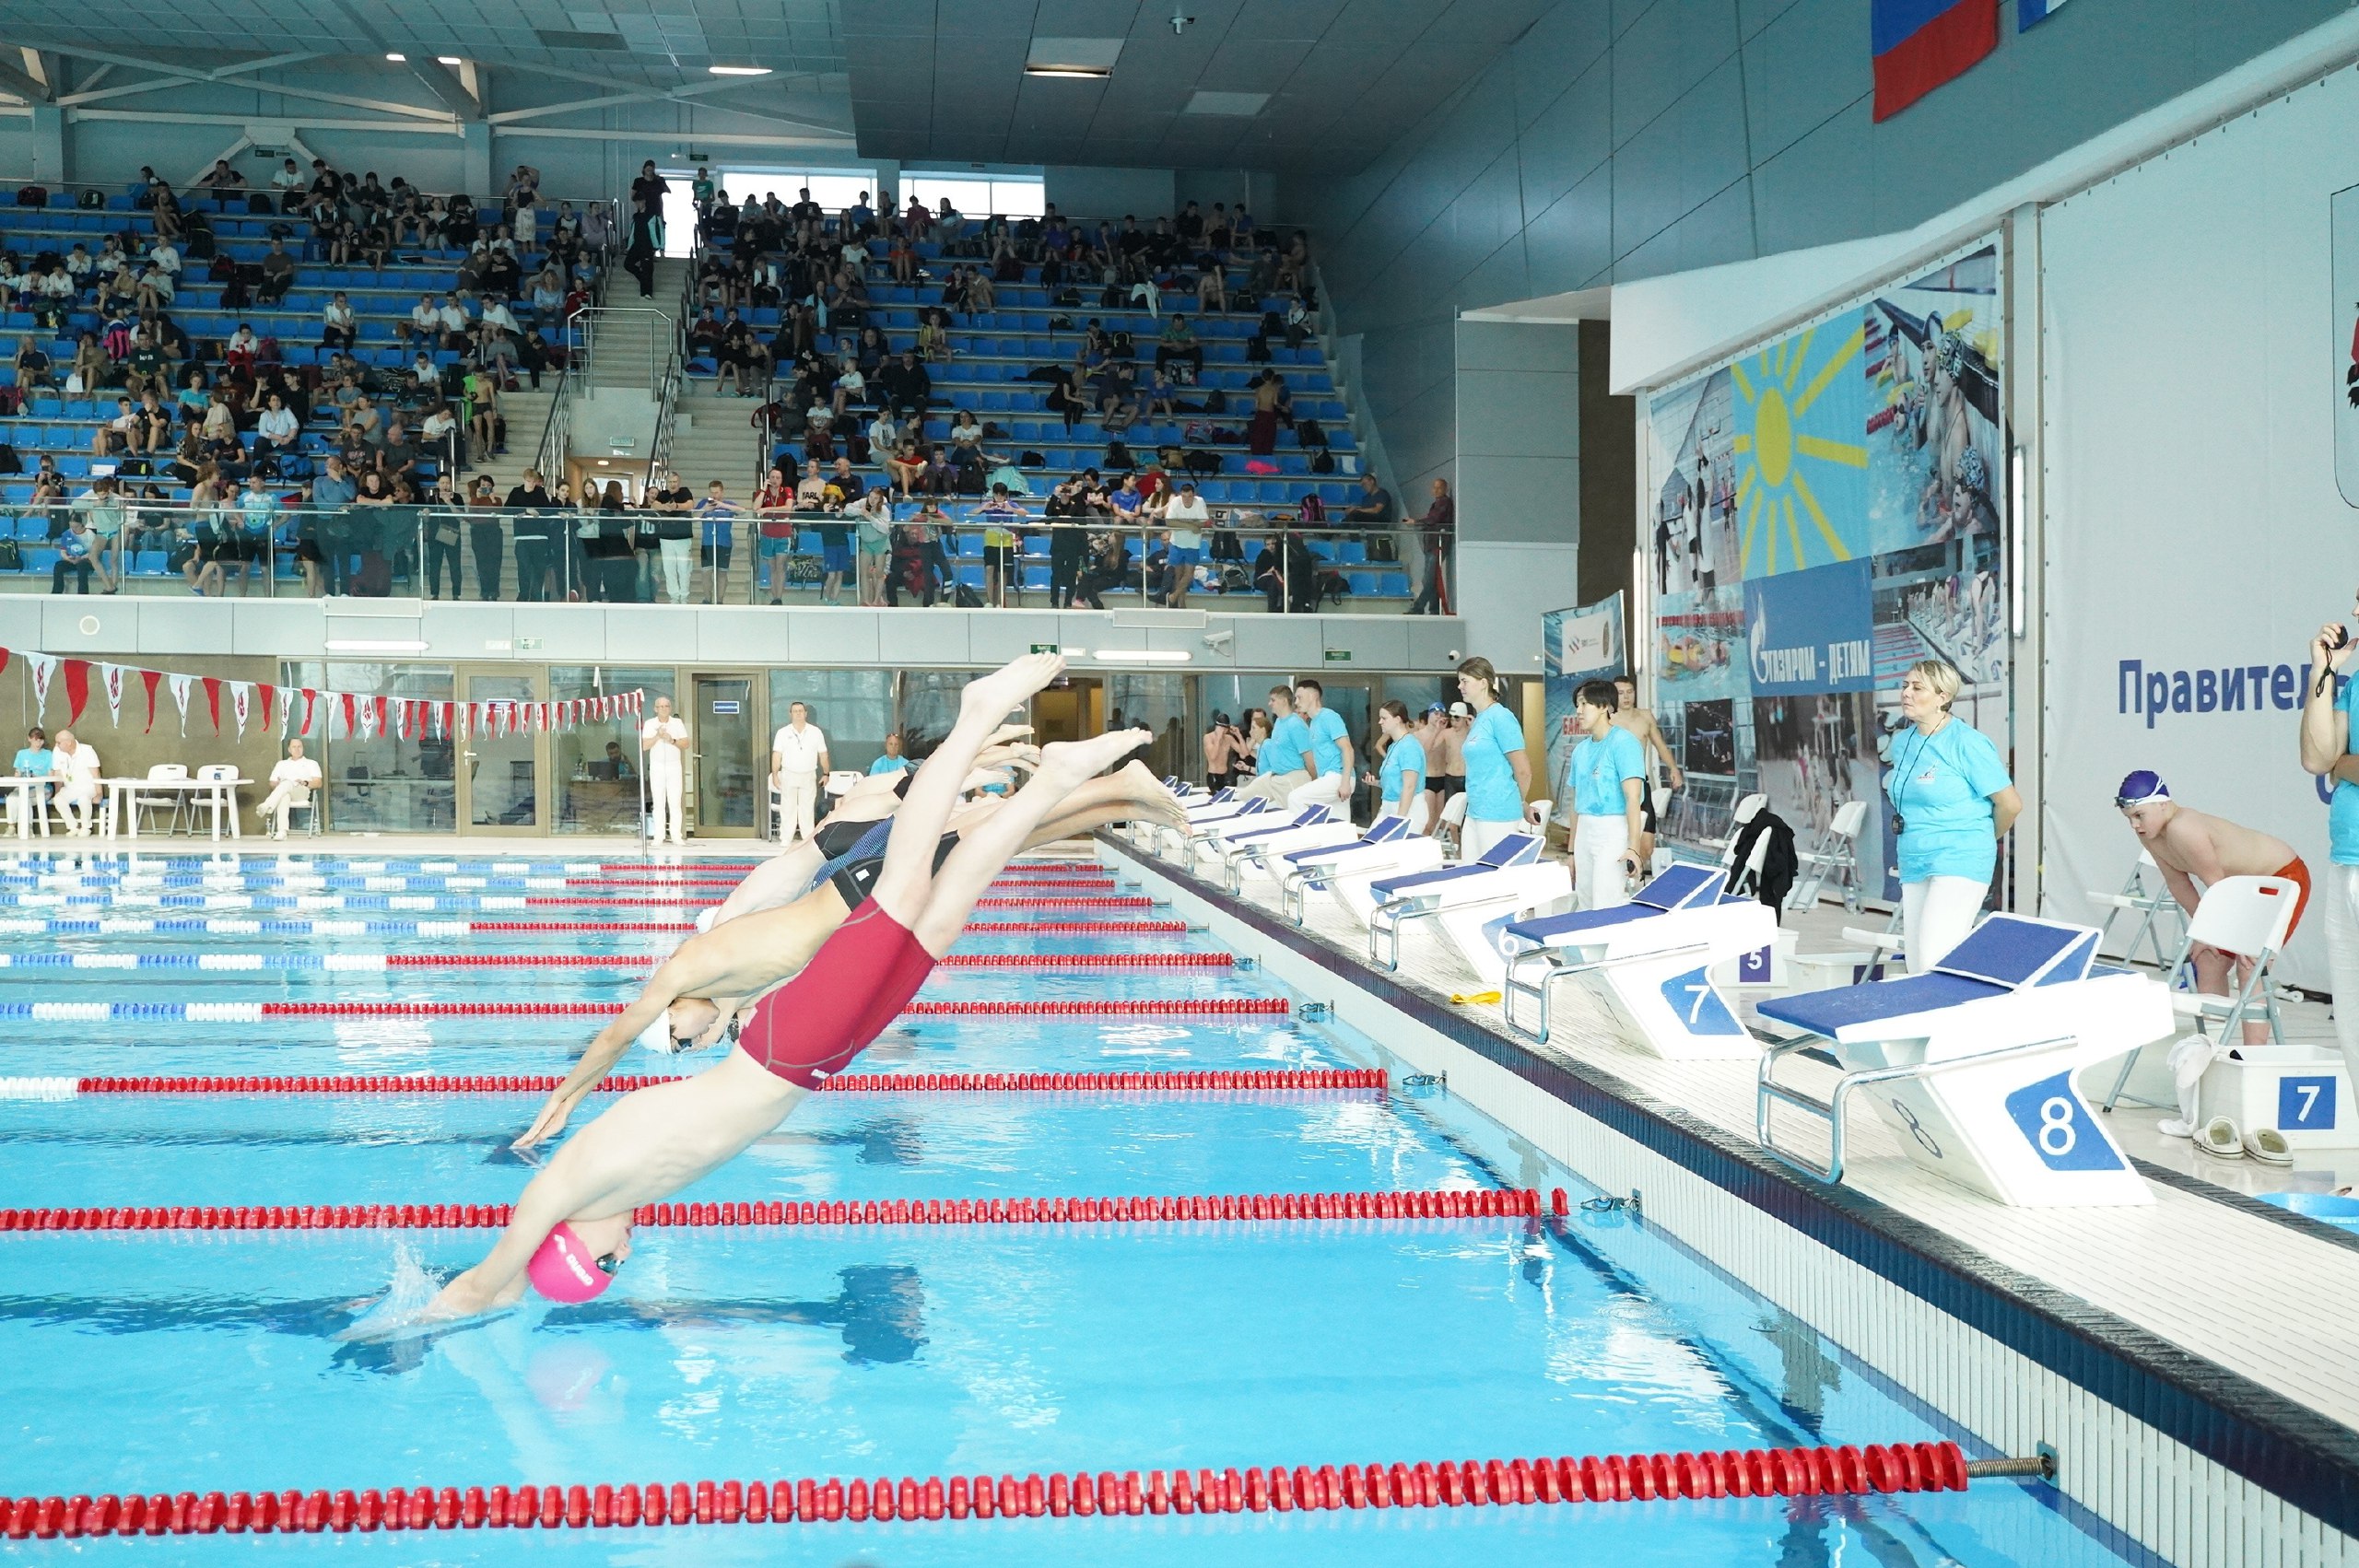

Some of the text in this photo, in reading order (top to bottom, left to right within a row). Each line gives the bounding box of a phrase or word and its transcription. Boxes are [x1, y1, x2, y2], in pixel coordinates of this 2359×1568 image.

[1828, 639, 1871, 685] ДЕТЯМ
[2119, 659, 2351, 729] Правите
[1498, 926, 1520, 956] 6
[1747, 948, 1763, 970] 5
[1684, 985, 1710, 1024] 7
[2296, 1085, 2320, 1123] 7
[1892, 1097, 1942, 1159] 8
[2039, 1096, 2076, 1156] 8
[566, 1254, 594, 1286] arena
